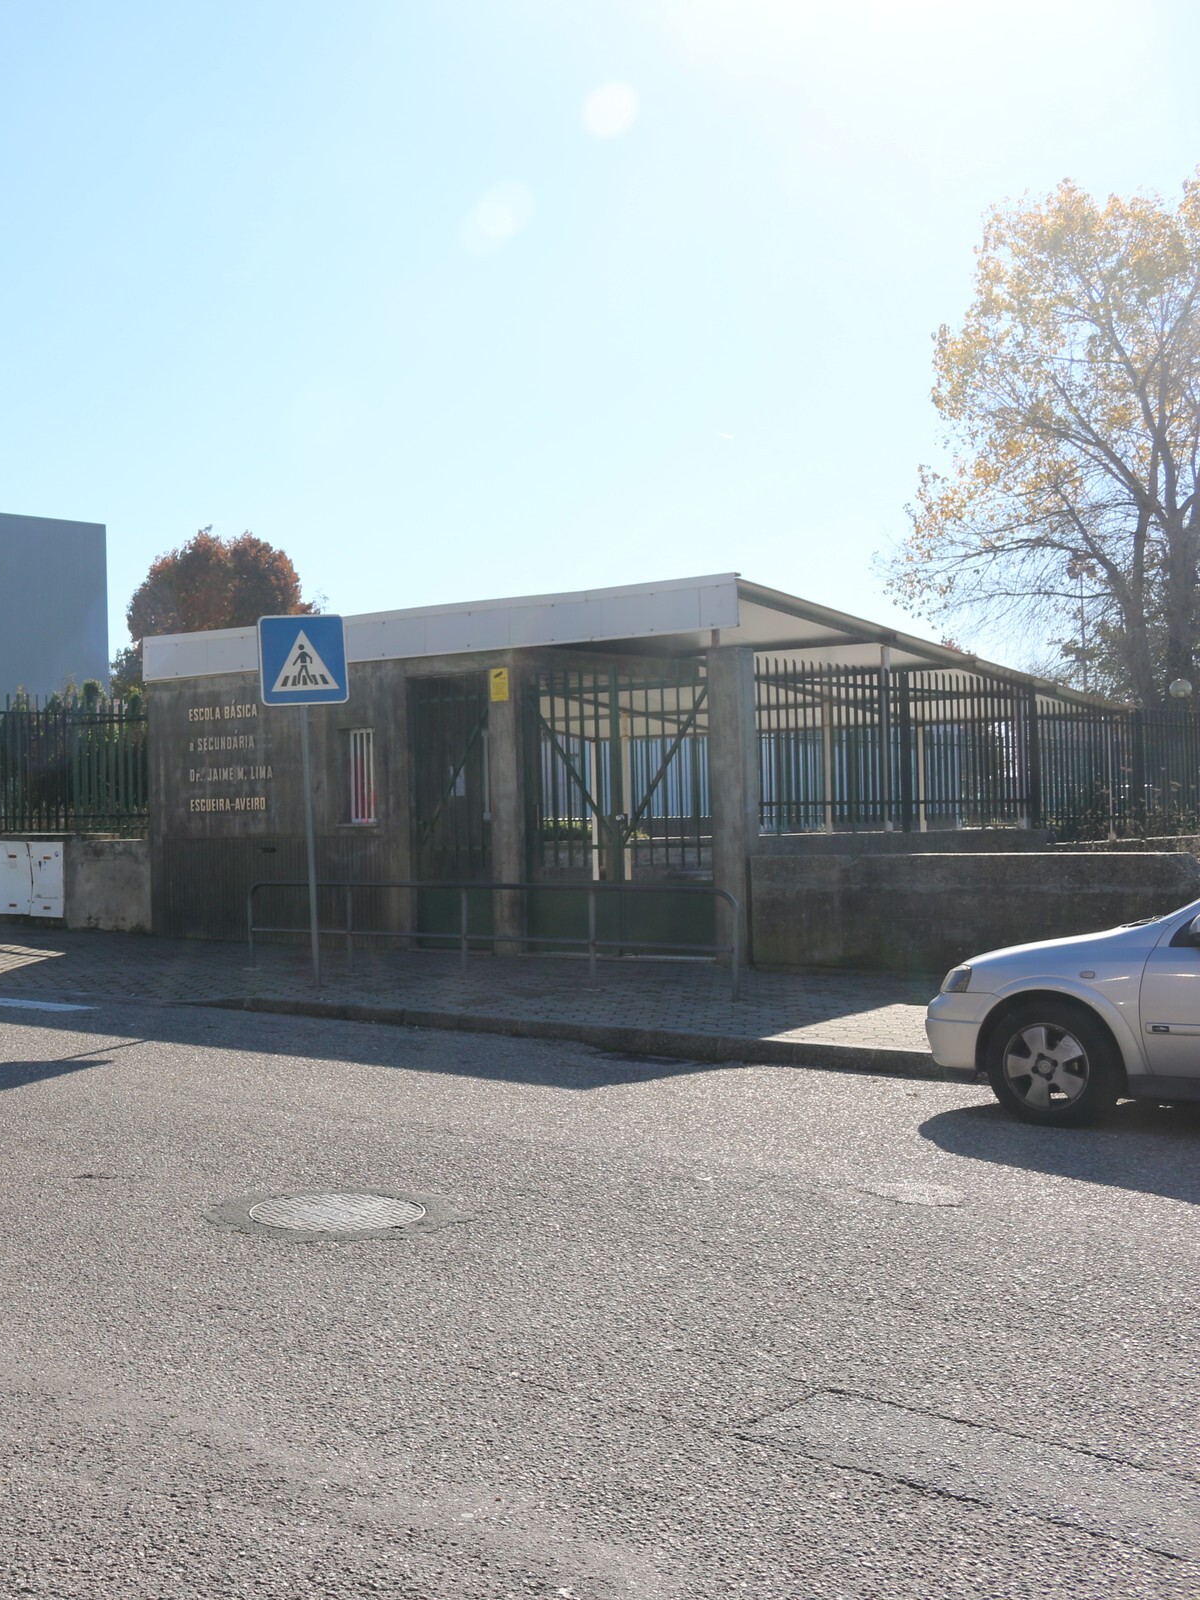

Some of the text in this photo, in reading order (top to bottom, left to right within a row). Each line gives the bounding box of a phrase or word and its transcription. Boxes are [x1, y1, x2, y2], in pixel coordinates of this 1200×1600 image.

[188, 699, 258, 722] ESCOLA BÁSICA
[197, 729, 255, 751] SECUNDÁRIA
[189, 765, 273, 782] Dr. JAIME M. LIMA
